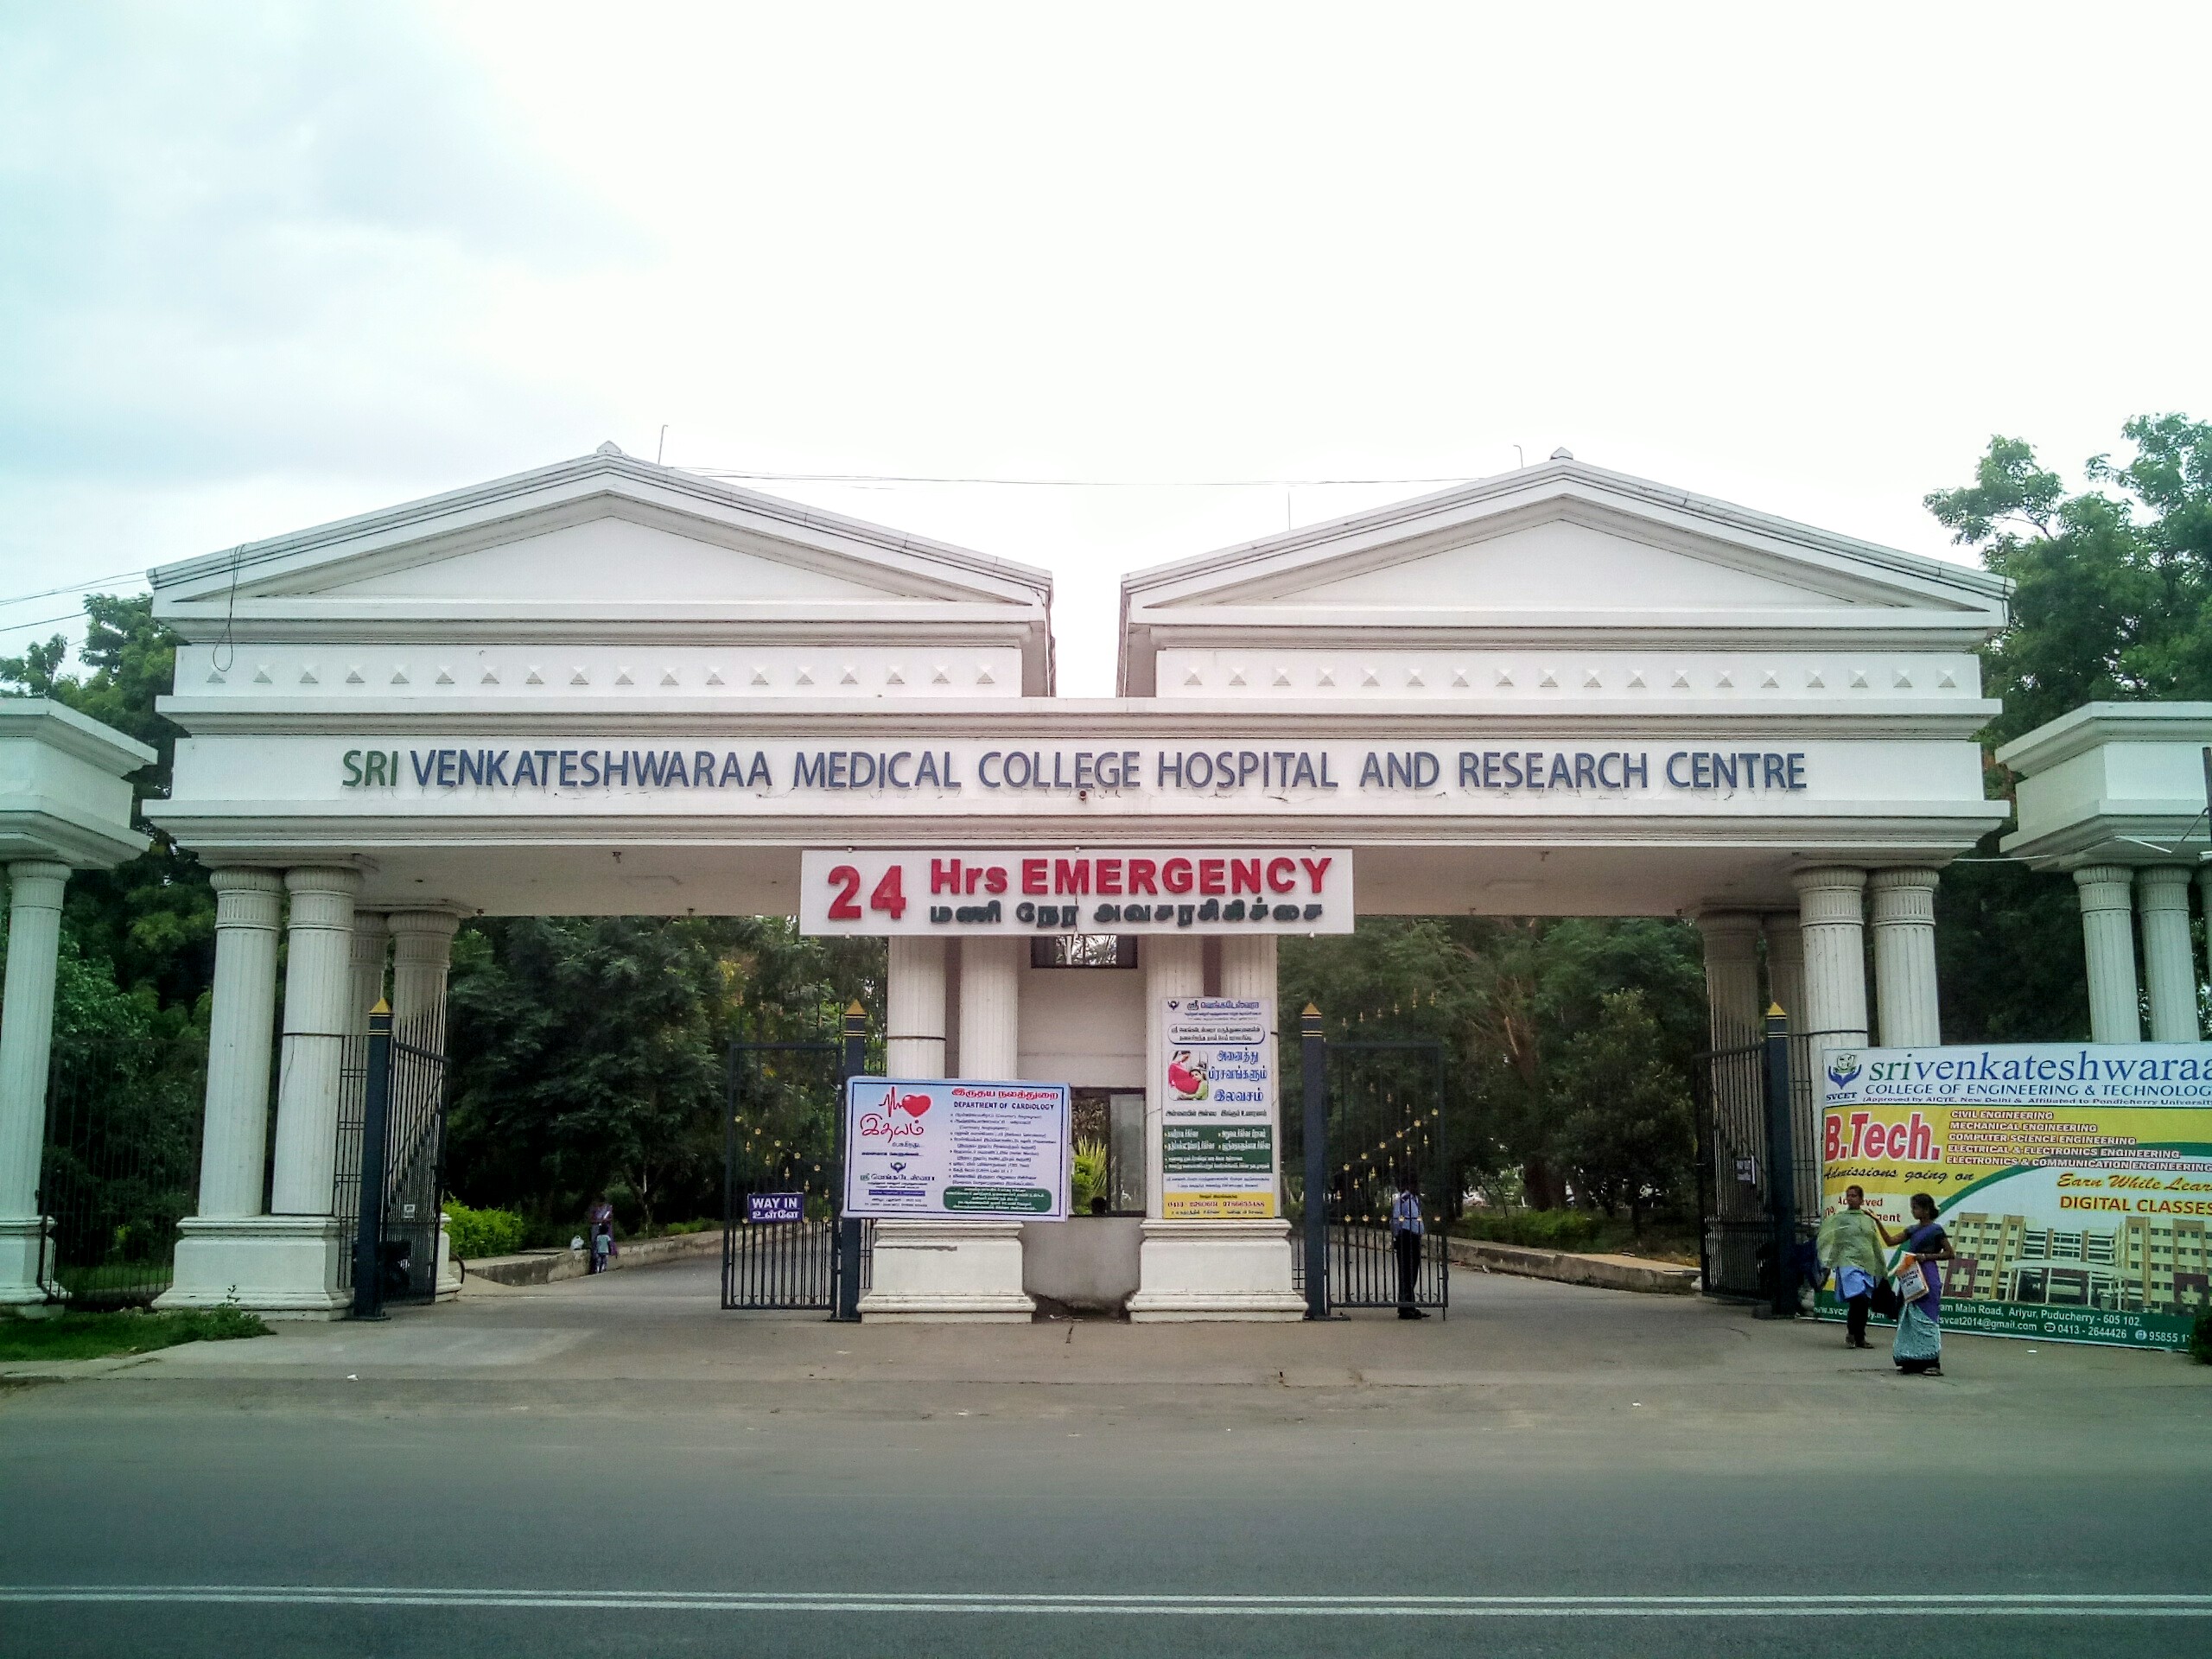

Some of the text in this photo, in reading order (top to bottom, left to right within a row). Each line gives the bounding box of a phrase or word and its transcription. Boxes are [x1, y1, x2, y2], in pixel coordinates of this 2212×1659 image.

[342, 750, 1807, 788] SRI VENKATESHWARAA MEDICAL COLLEGE HOSPITAL AND RESEARCH CENTRE
[829, 856, 1332, 919] 24 Hrs EMERGENCY
[1827, 1091, 1858, 1101] SVCET
[1866, 1084, 1933, 1095] COLLEGE
[1939, 1084, 1961, 1095] OF
[1967, 1084, 2078, 1096] ENGINEERING
[2085, 1084, 2095, 1096] &
[953, 1101, 997, 1109] DEPARTMENT
[1011, 1103, 1055, 1111] CARDIOLOGY
[1950, 1109, 2054, 1121] CIVIL ENGINEERING
[1949, 1122, 2097, 1133] MECHANICAL ENGINEERING
[1824, 1112, 1941, 1162] B.Tech.
[1948, 1133, 2137, 1146] COMPUTER SCIENCE ENGINEERING
[1947, 1144, 2181, 1159] ELECTRICAL & ELECTRONICS ENGINEERING
[1946, 1155, 2212, 1173] ELECTRONICS & COMMUNICATION ENGINEERING
[1824, 1166, 1974, 1183] Admissions going on
[2057, 1173, 2102, 1187] Earn
[2108, 1174, 2160, 1190] While
[752, 1198, 798, 1209] WAY IN
[2059, 1195, 2132, 1211] DIGITAL
[1955, 1303, 1976, 1313] Main
[1978, 1305, 2004, 1316] Road,
[2009, 1306, 2038, 1319] Ariyur,
[2041, 1309, 2095, 1324] Puducherry
[2103, 1314, 2120, 1325] 605
[2057, 1324, 2080, 1335] 0413
[2088, 1326, 2127, 1339] 2644426
[2149, 1331, 2178, 1343] 95855
